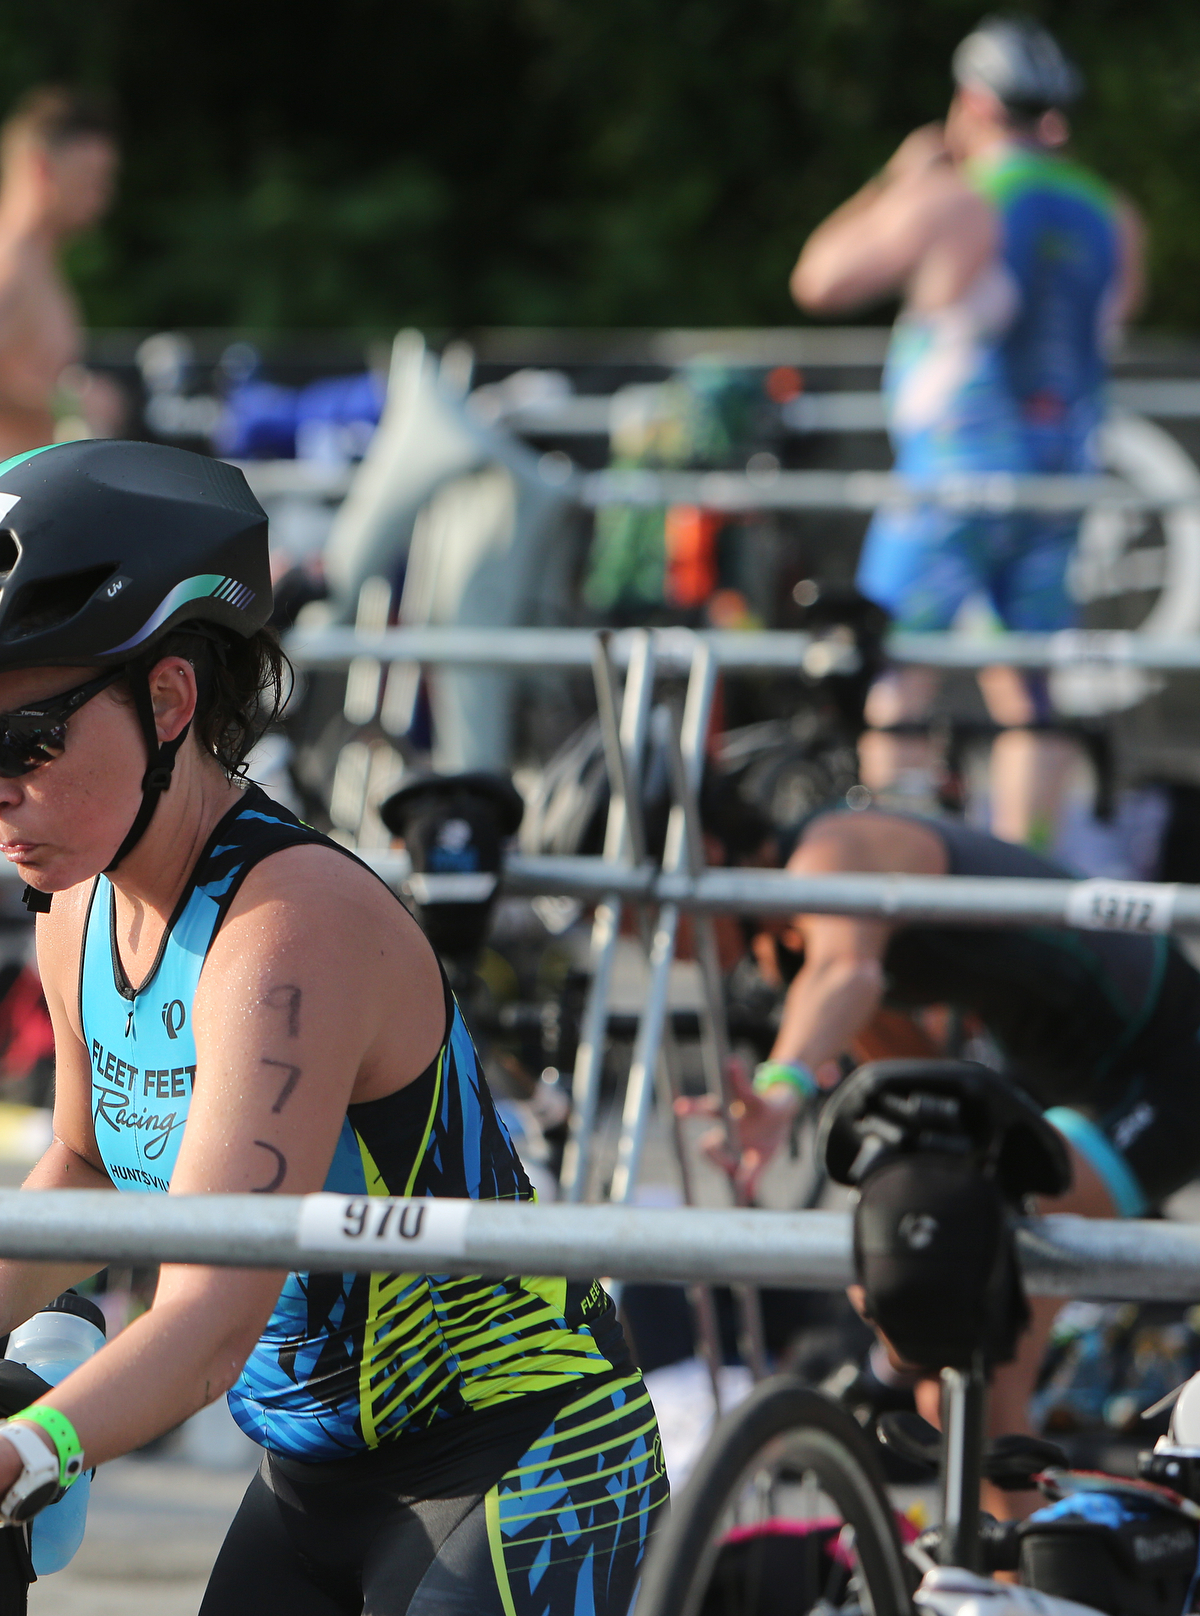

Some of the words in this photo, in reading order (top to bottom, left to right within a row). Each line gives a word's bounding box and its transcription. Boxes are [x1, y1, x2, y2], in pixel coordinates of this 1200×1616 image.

[107, 580, 123, 597] Liv
[92, 1038, 139, 1092] FLEET
[143, 1064, 198, 1099] FEET
[92, 1083, 188, 1161] Racing
[343, 1202, 426, 1239] 970
